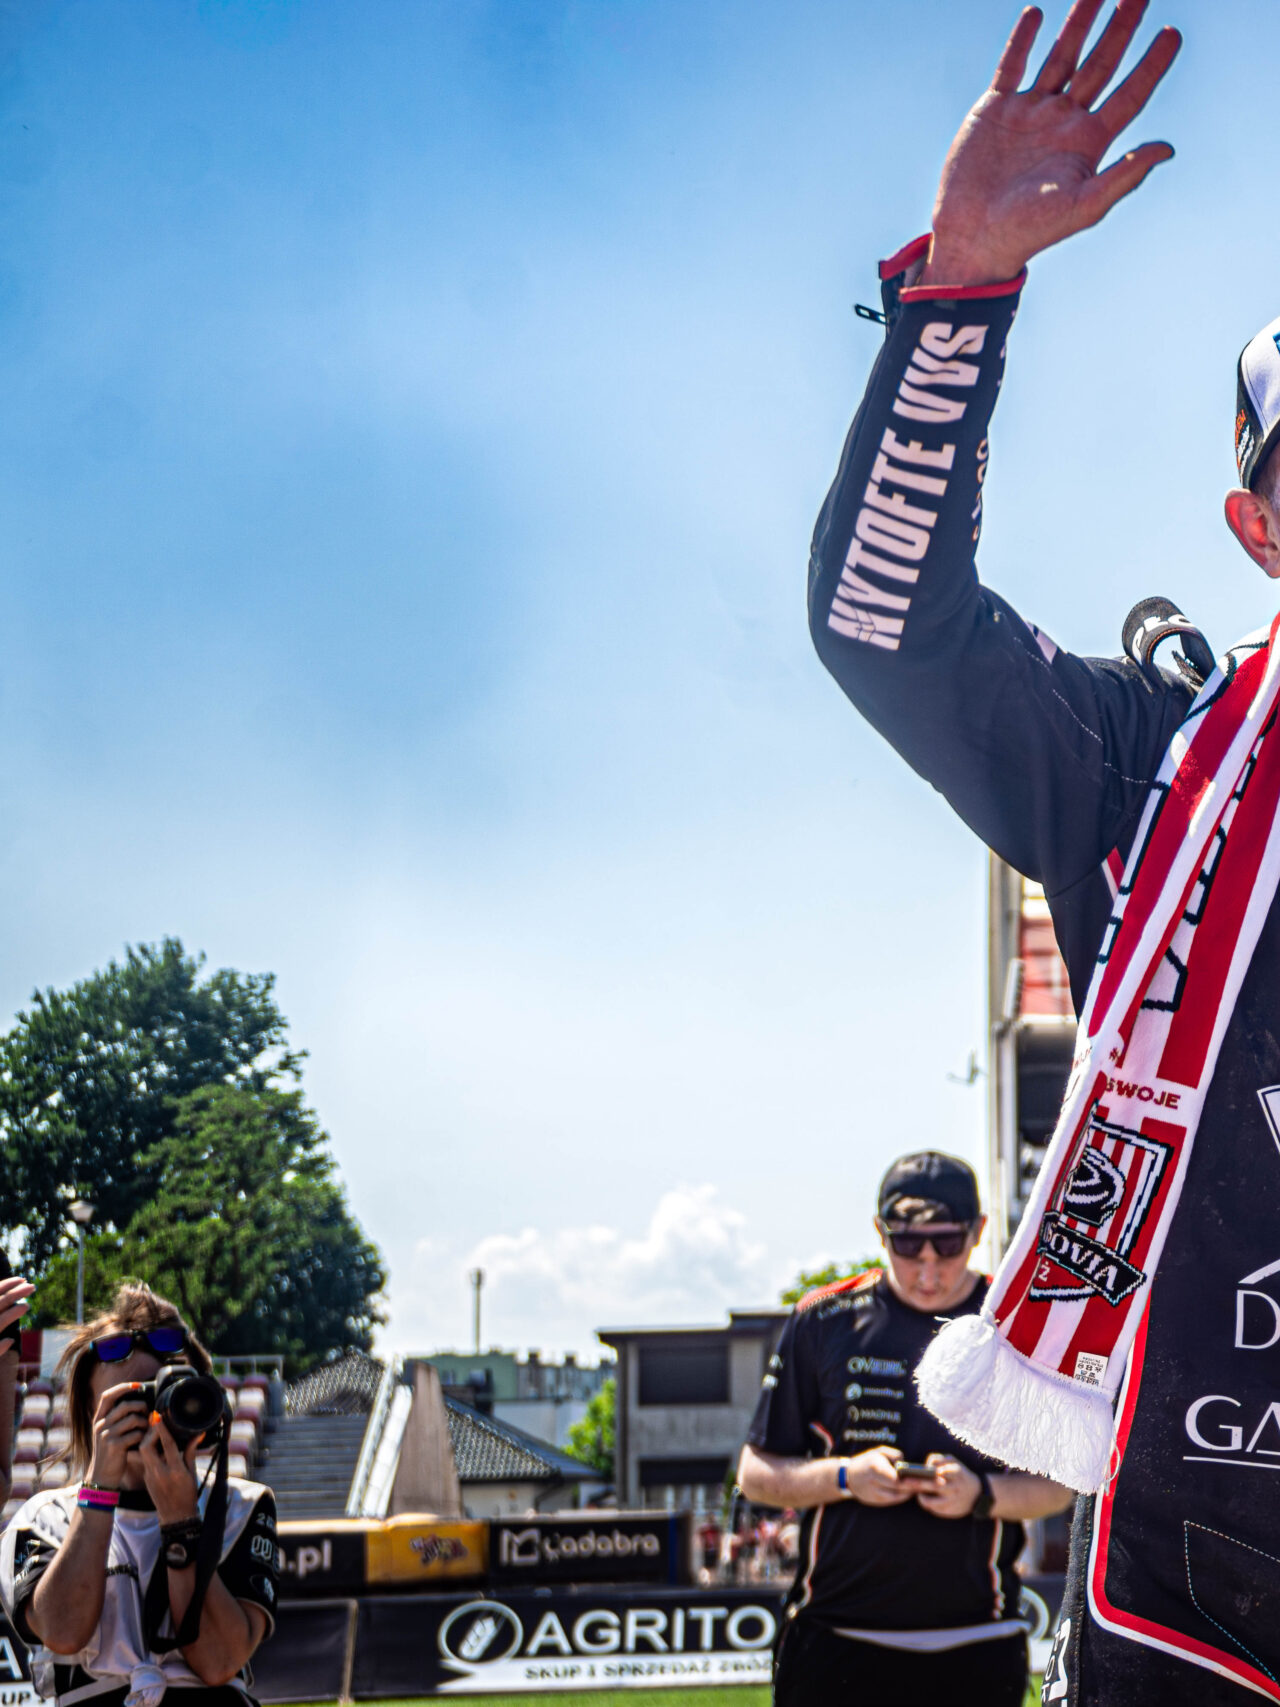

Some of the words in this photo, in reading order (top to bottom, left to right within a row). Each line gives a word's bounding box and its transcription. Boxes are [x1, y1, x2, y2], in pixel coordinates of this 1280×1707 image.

[828, 427, 956, 651] NYTOFTE
[526, 1604, 778, 1655] AGRITO
[525, 1666, 582, 1680] SKUP
